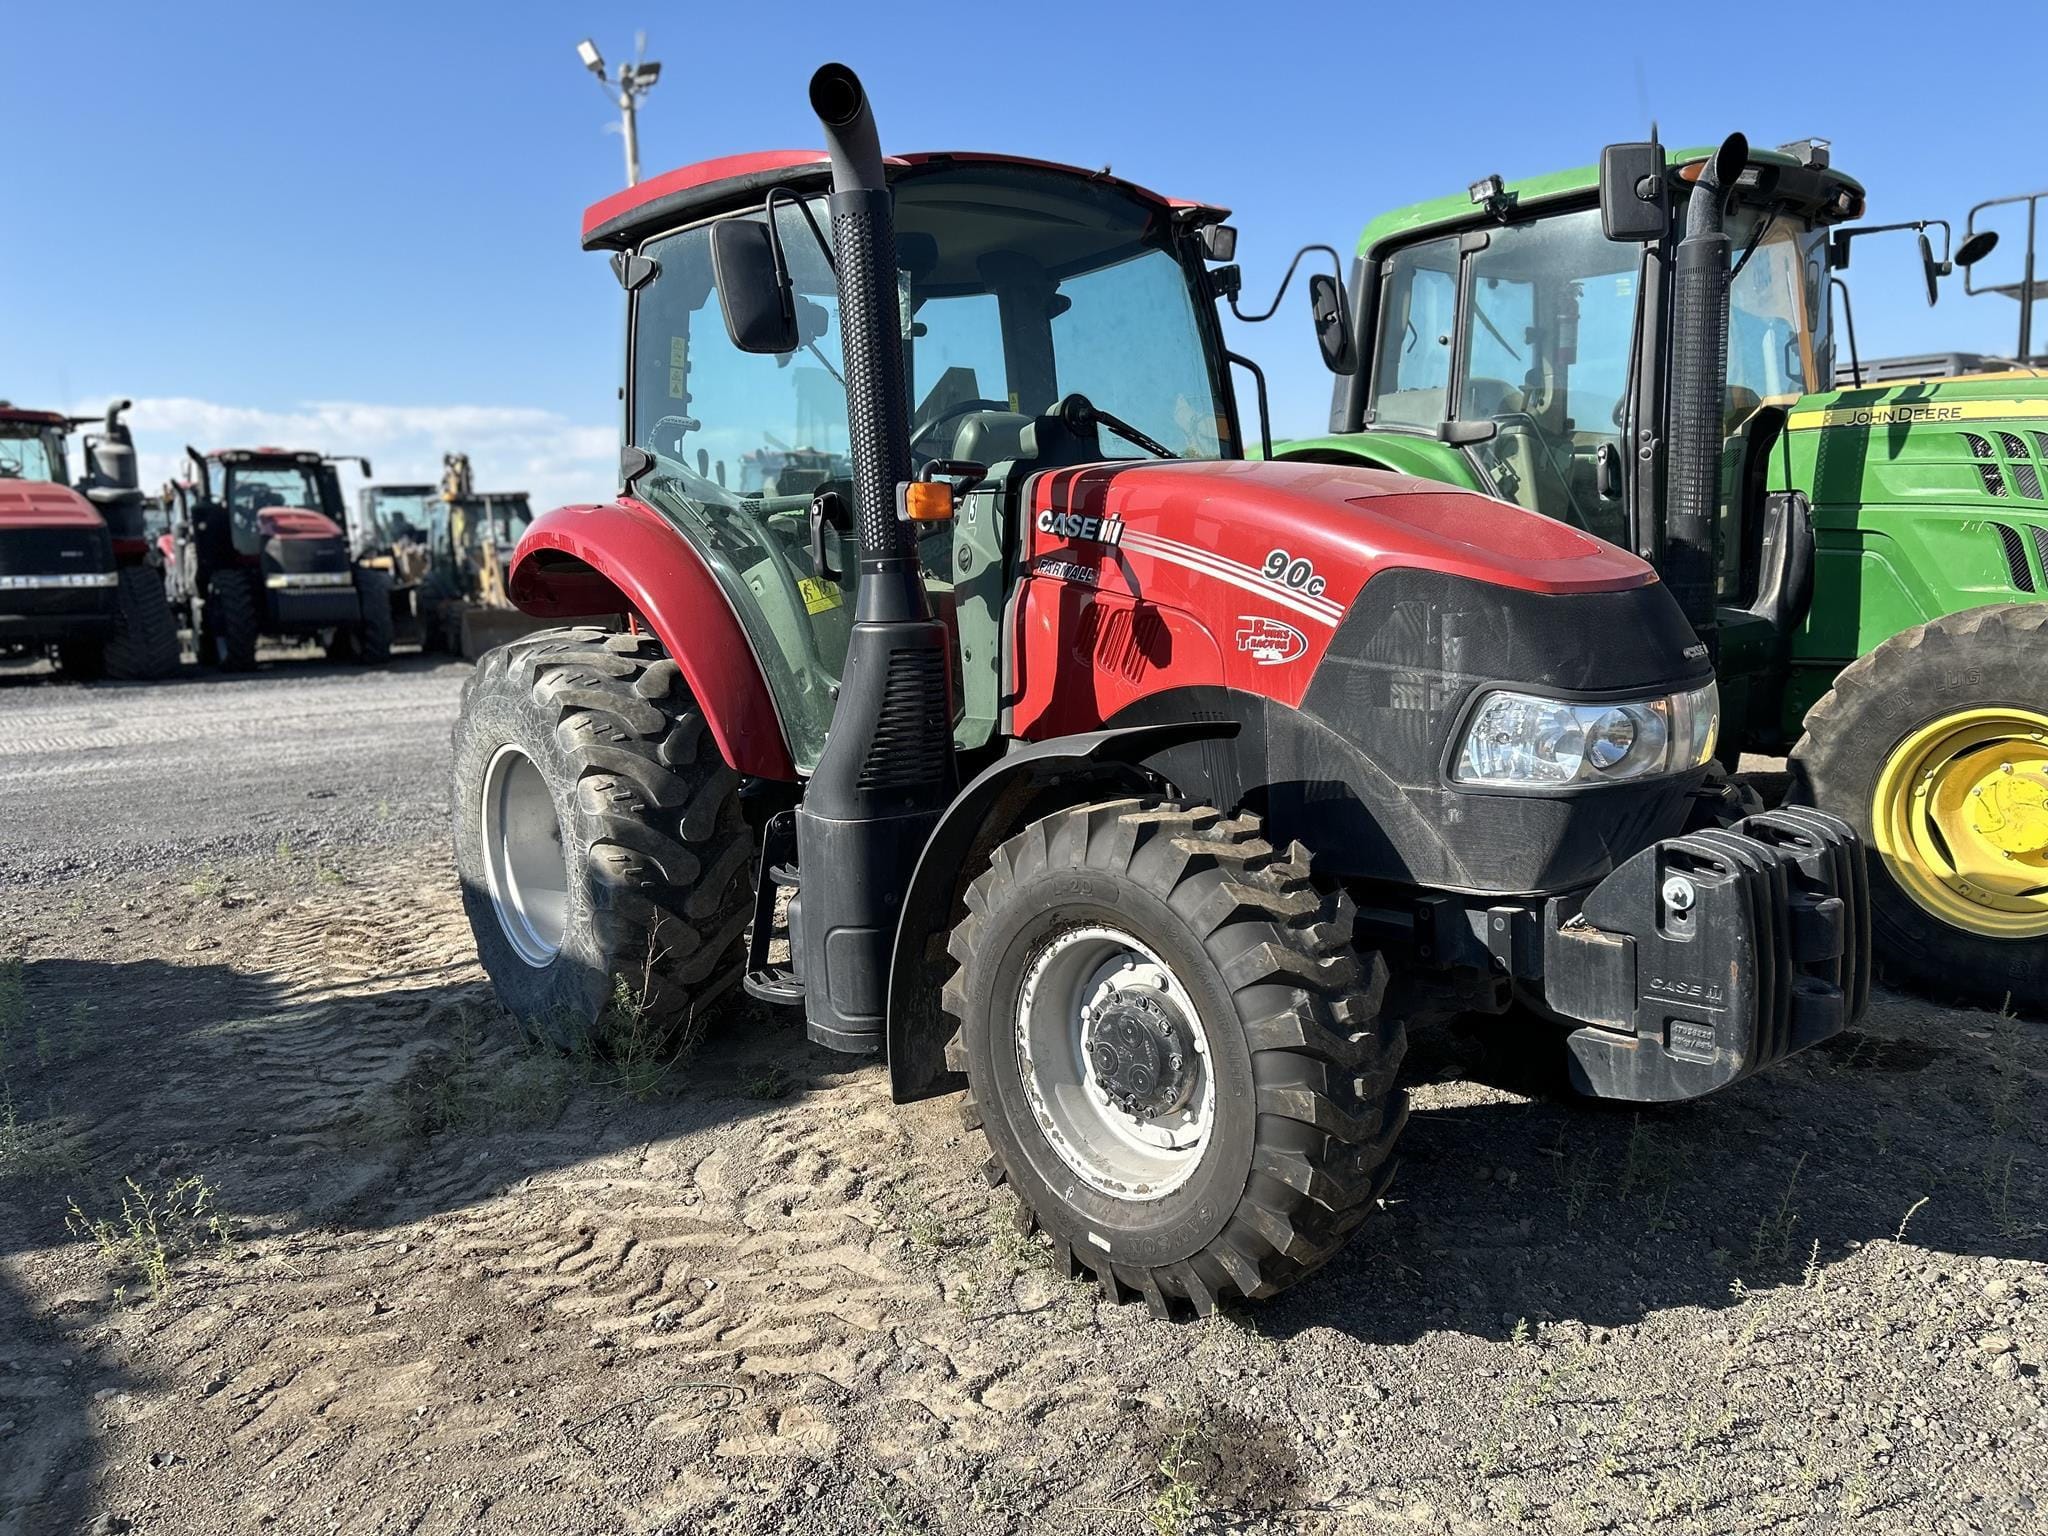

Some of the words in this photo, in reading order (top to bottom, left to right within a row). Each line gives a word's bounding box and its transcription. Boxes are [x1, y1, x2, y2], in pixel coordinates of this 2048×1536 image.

[1846, 409, 1896, 425] JOHN
[1898, 406, 1963, 422] DEERE
[1037, 508, 1099, 540] CASE
[1038, 559, 1095, 583] FARMALL
[1831, 686, 1914, 784] TRACTION
[1933, 666, 1983, 693] LUG
[1649, 977, 1702, 997] CASE
